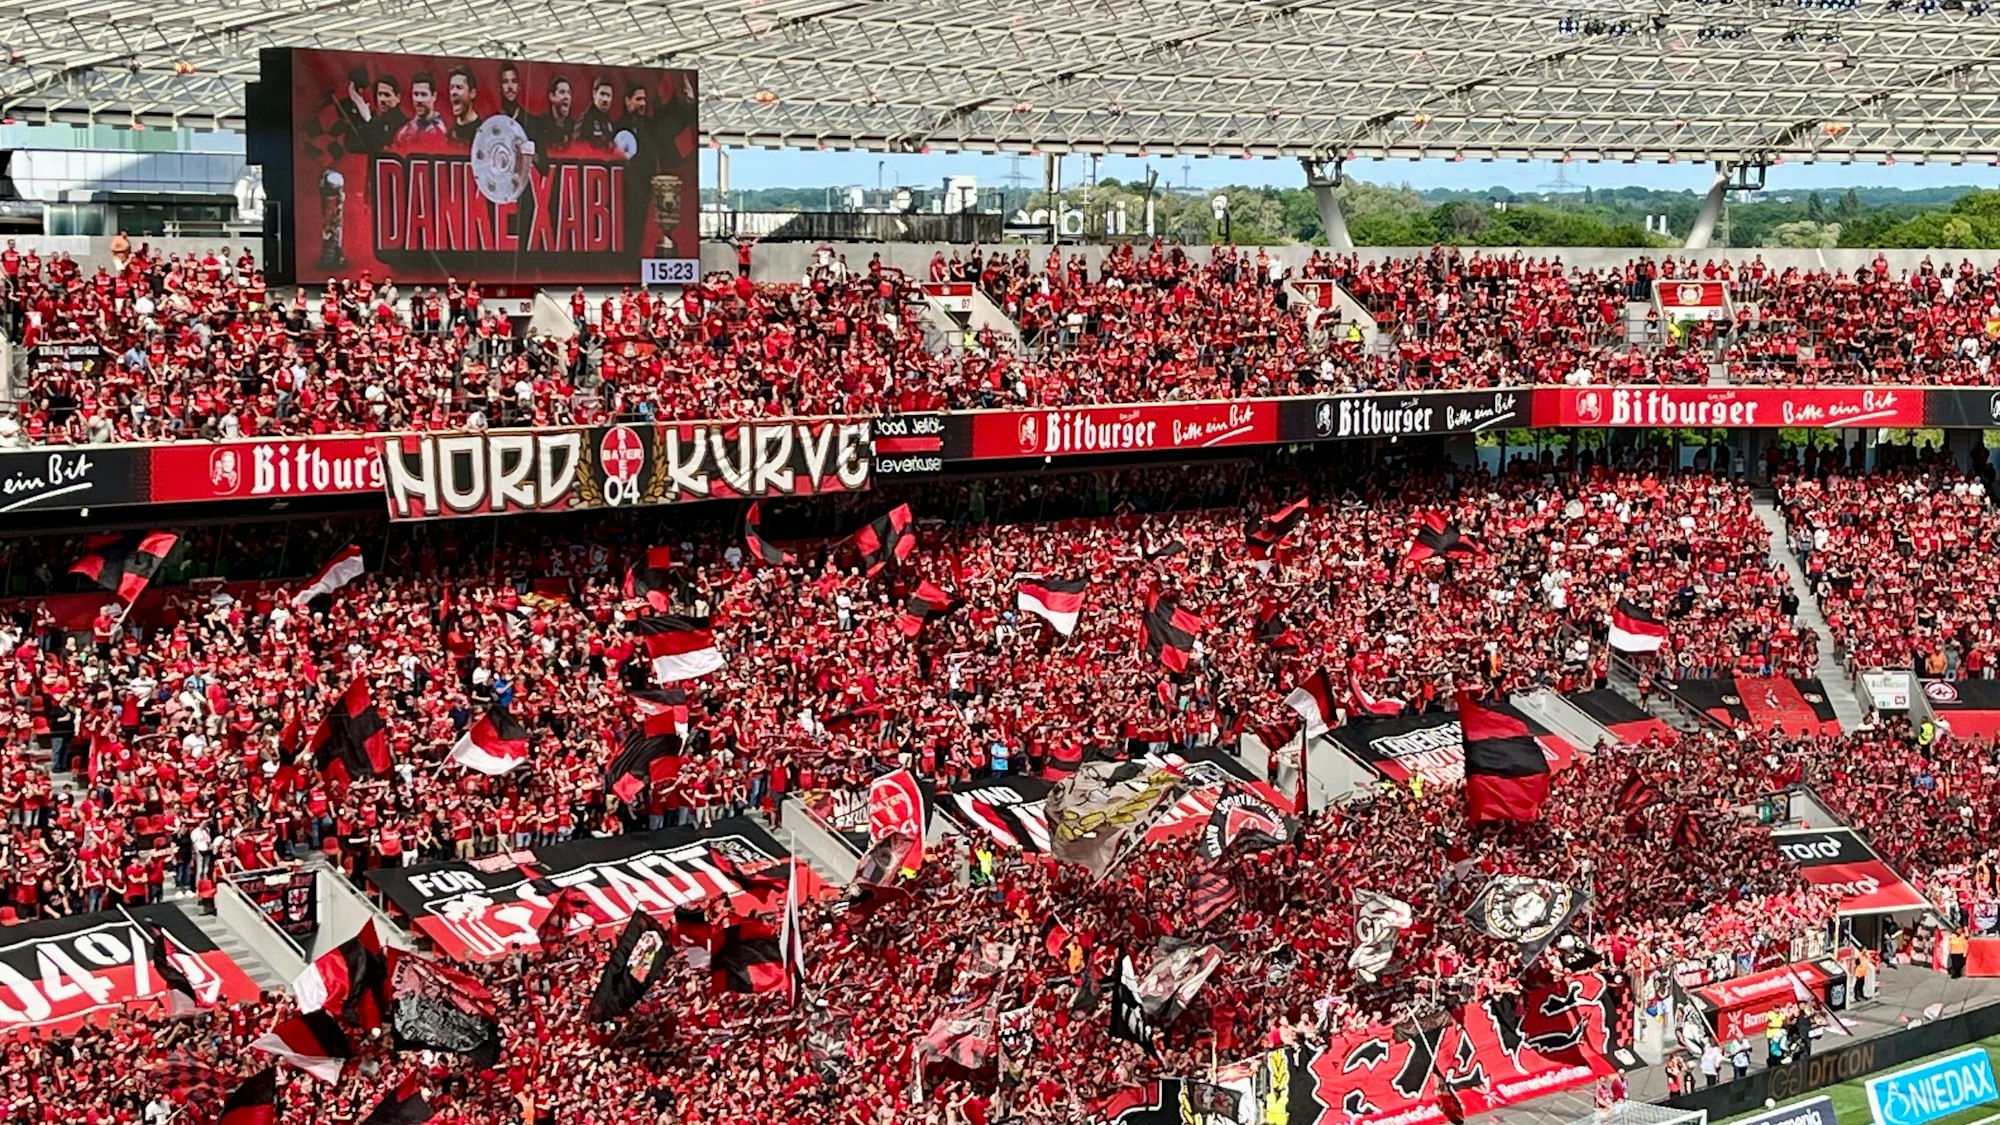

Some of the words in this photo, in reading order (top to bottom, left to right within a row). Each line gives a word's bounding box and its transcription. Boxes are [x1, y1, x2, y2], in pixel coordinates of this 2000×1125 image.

[527, 164, 624, 252] XABI
[649, 262, 695, 281] 15:23
[1172, 418, 1203, 445] Bitte
[1205, 416, 1228, 435] ein
[1229, 404, 1254, 427] Bit
[1337, 398, 1433, 437] Bitburger
[1446, 404, 1472, 430] Bitte
[1474, 404, 1494, 421] ein
[1495, 392, 1516, 414] Bit
[1610, 389, 1758, 425] Bitburger
[1782, 400, 1825, 425] Bitte
[1829, 396, 1861, 417] ein
[1863, 389, 1898, 411] Bit
[1043, 411, 1156, 452] Bitburger
[3, 471, 45, 494] ein
[48, 453, 94, 485] Bit
[250, 444, 385, 496] Bitburg
[384, 432, 582, 516] NORD
[664, 420, 871, 497] KURVE
[602, 448, 642, 461] BAYER
[603, 473, 641, 507] 04
[408, 869, 487, 898] FÜR
[1808, 1044, 1875, 1087] DITCON
[1908, 1060, 1993, 1118] NIEDAX
